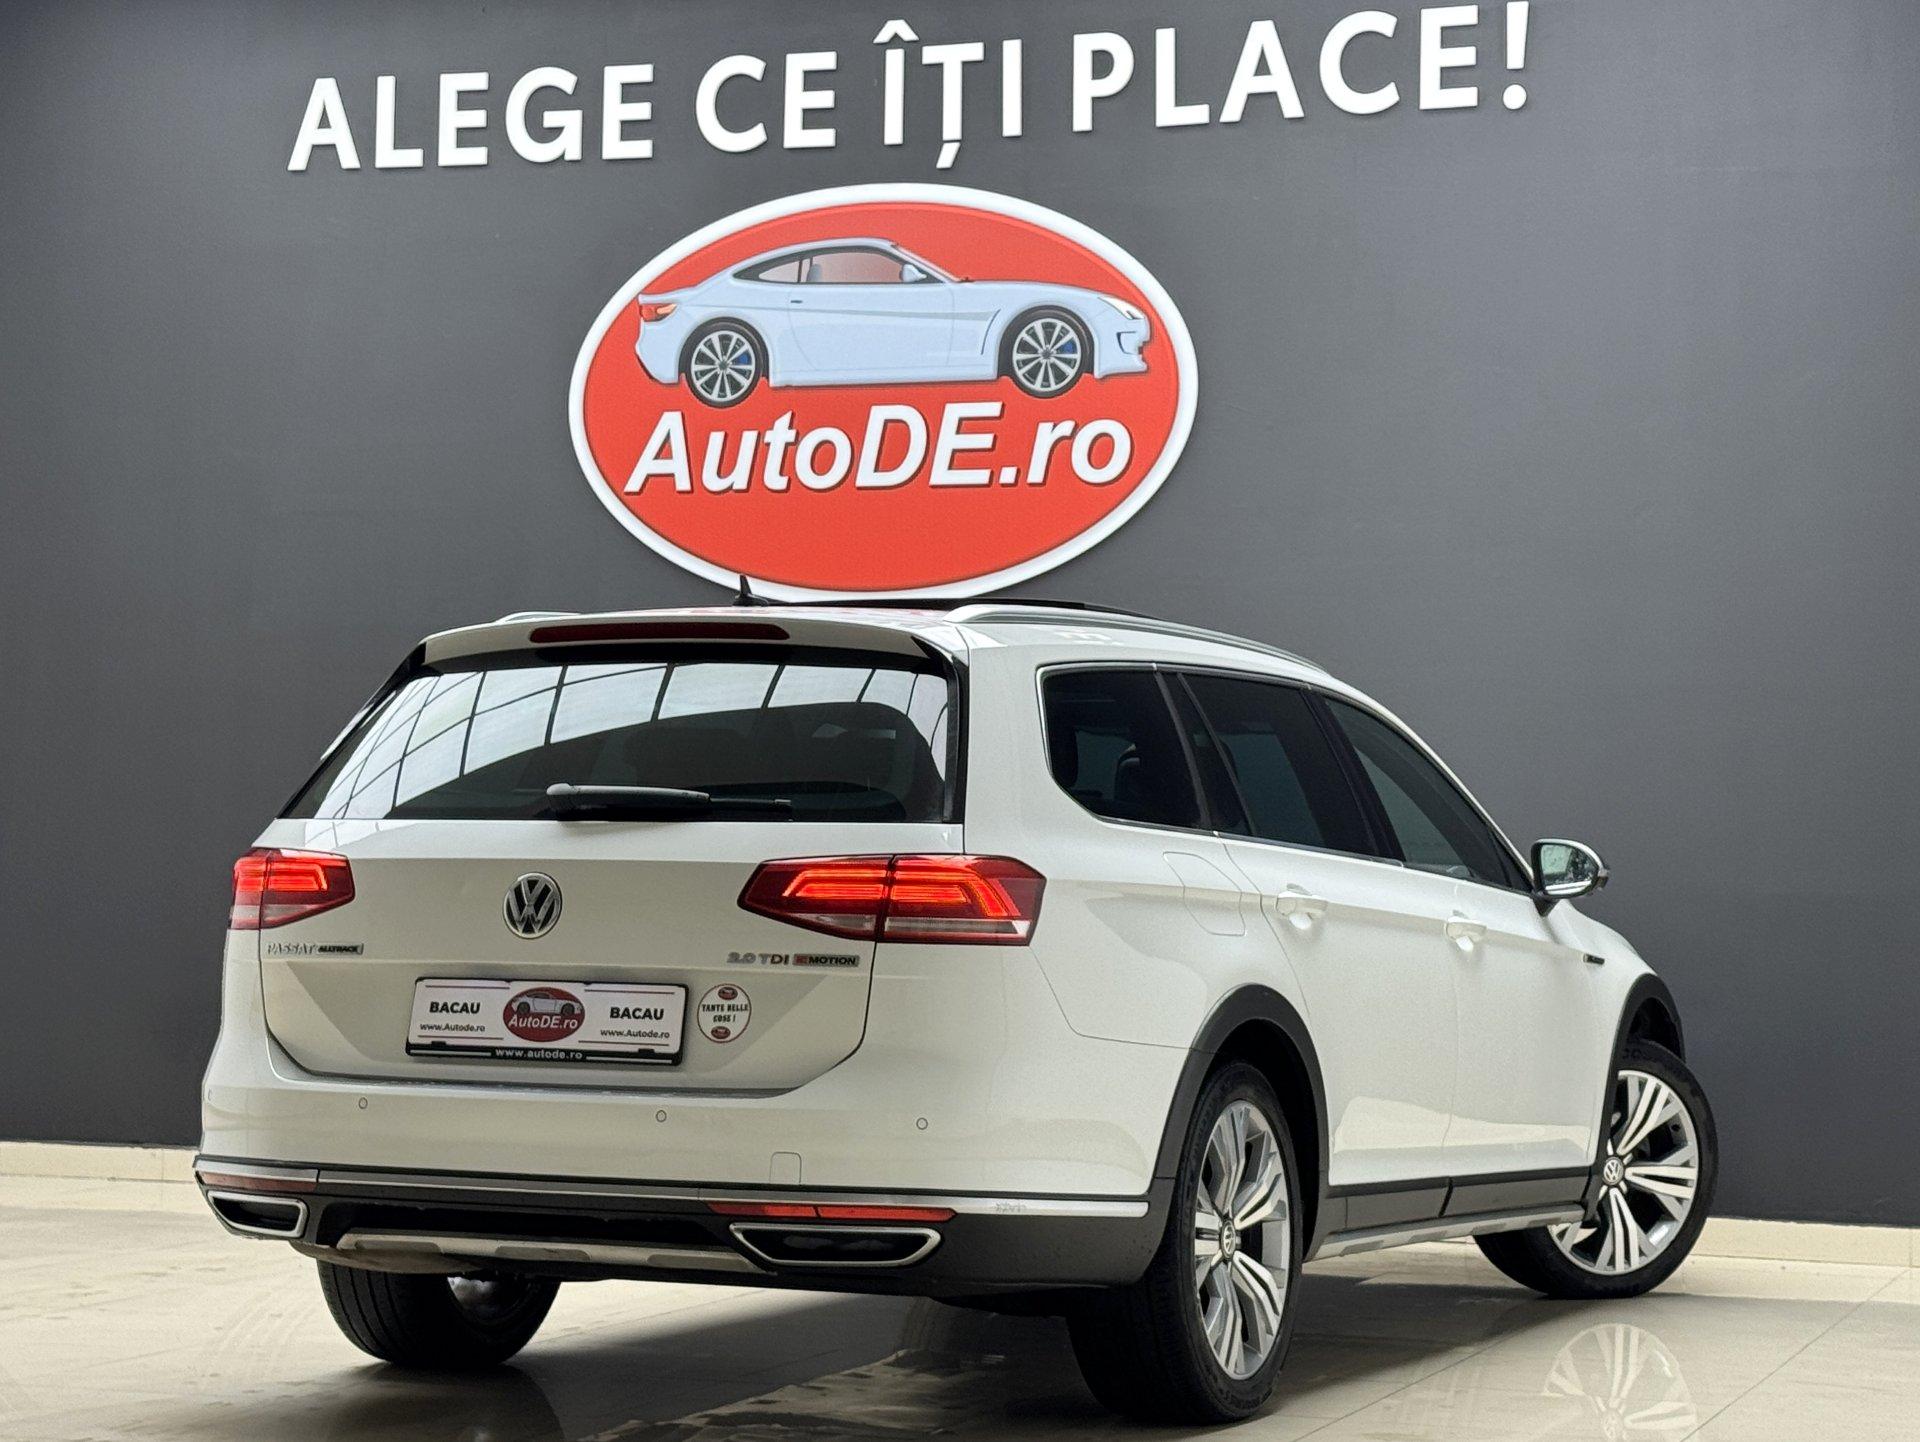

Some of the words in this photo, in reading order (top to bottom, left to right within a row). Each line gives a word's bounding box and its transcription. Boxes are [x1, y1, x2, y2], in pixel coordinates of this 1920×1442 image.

[287, 63, 654, 171] ALEGE
[695, 51, 837, 152] CE
[1072, 1, 1529, 132] PLACE!
[623, 401, 1132, 493] AutoDE.ro
[758, 953, 790, 965] TDI
[429, 1001, 481, 1014] BACAU
[609, 1006, 665, 1021] BACAU
[702, 1003, 725, 1012] TANTE
[420, 1022, 486, 1033] www.Autode.ro
[508, 1014, 578, 1030] AutoDE.ro
[600, 1028, 671, 1040] www.Autode.ro
[495, 1048, 583, 1060] www.autode.ro
